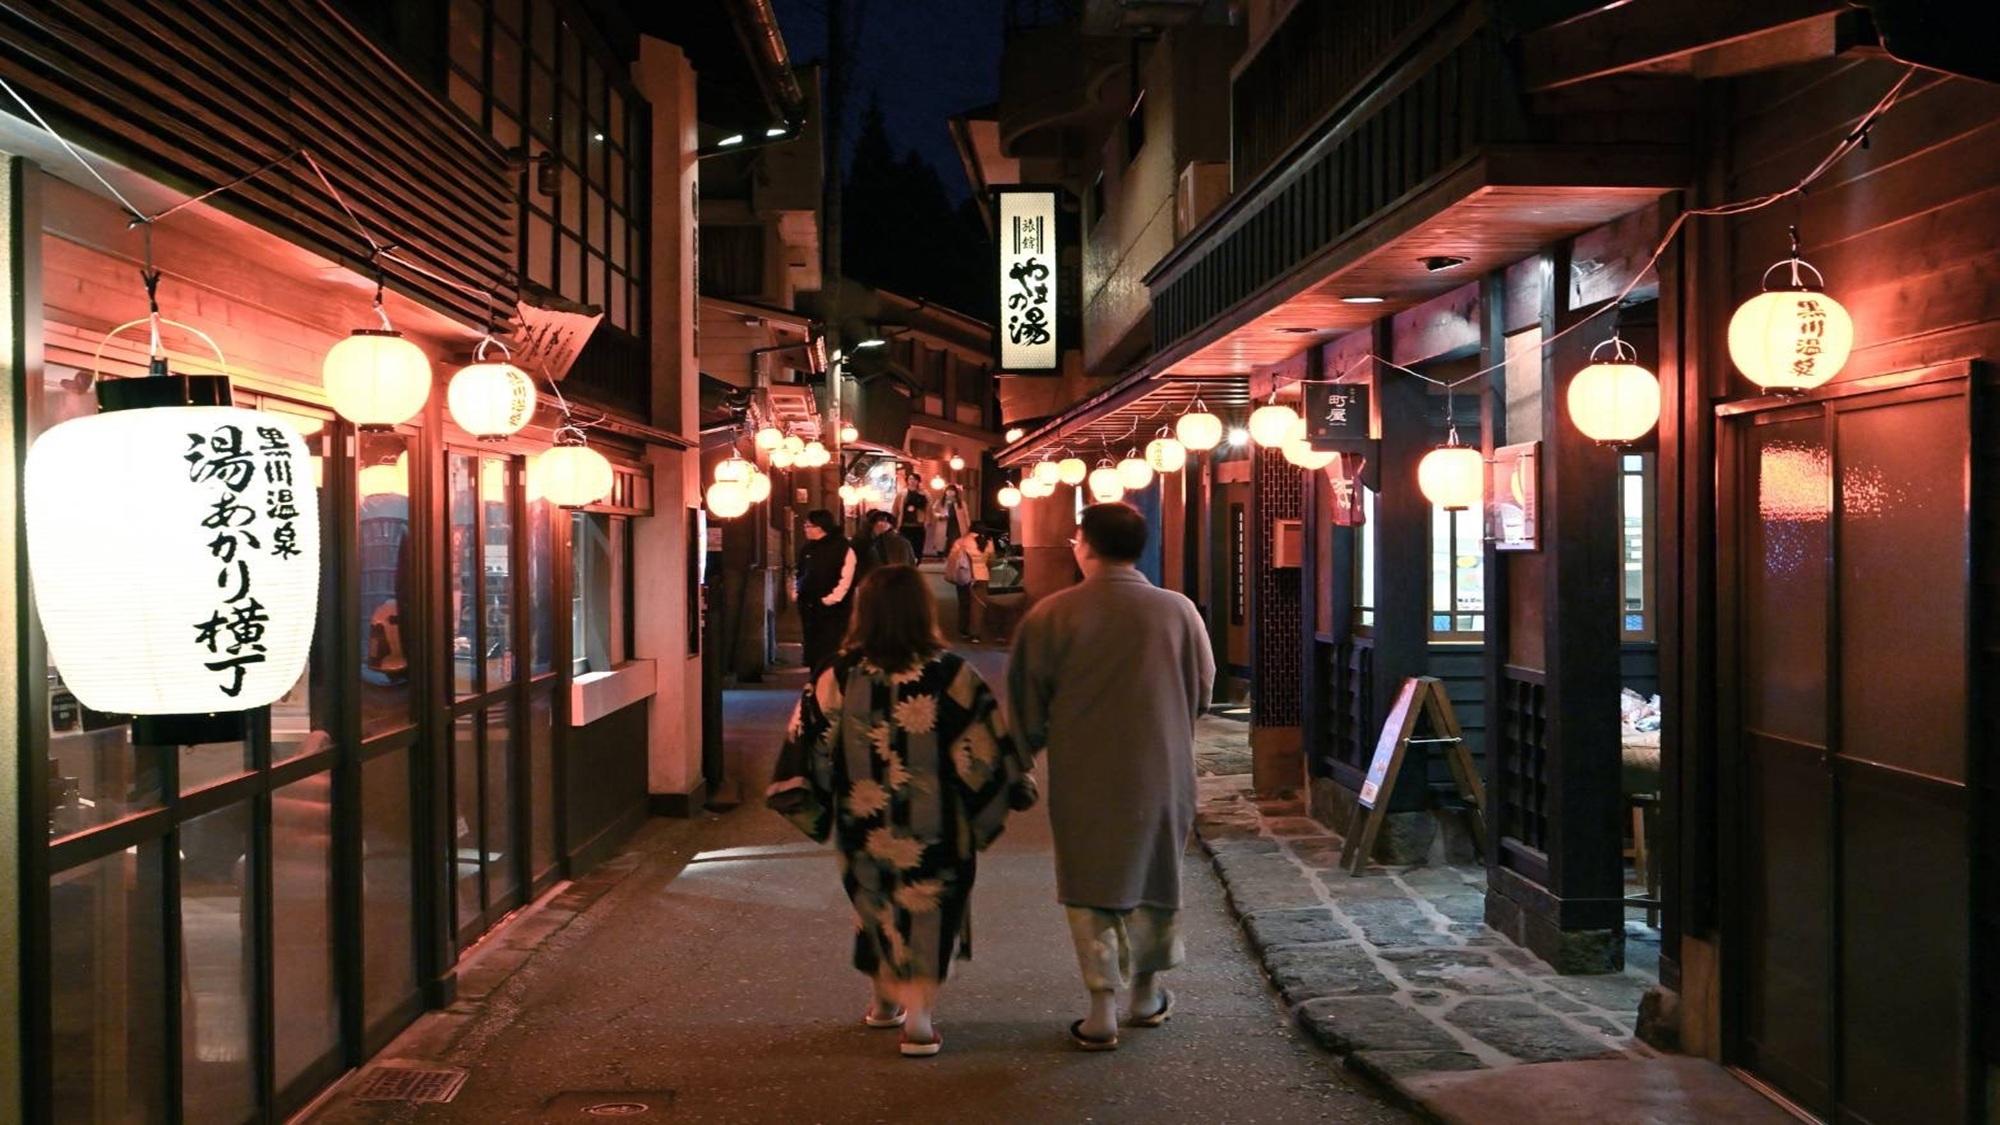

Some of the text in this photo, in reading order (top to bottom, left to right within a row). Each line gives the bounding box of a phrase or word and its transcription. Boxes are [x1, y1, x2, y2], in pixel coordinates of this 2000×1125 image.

[1790, 300, 1826, 376] 黒川温泉
[1325, 394, 1349, 421] 町屋
[256, 426, 302, 560] 黒川温泉
[184, 424, 270, 697] 湯あかり横丁
